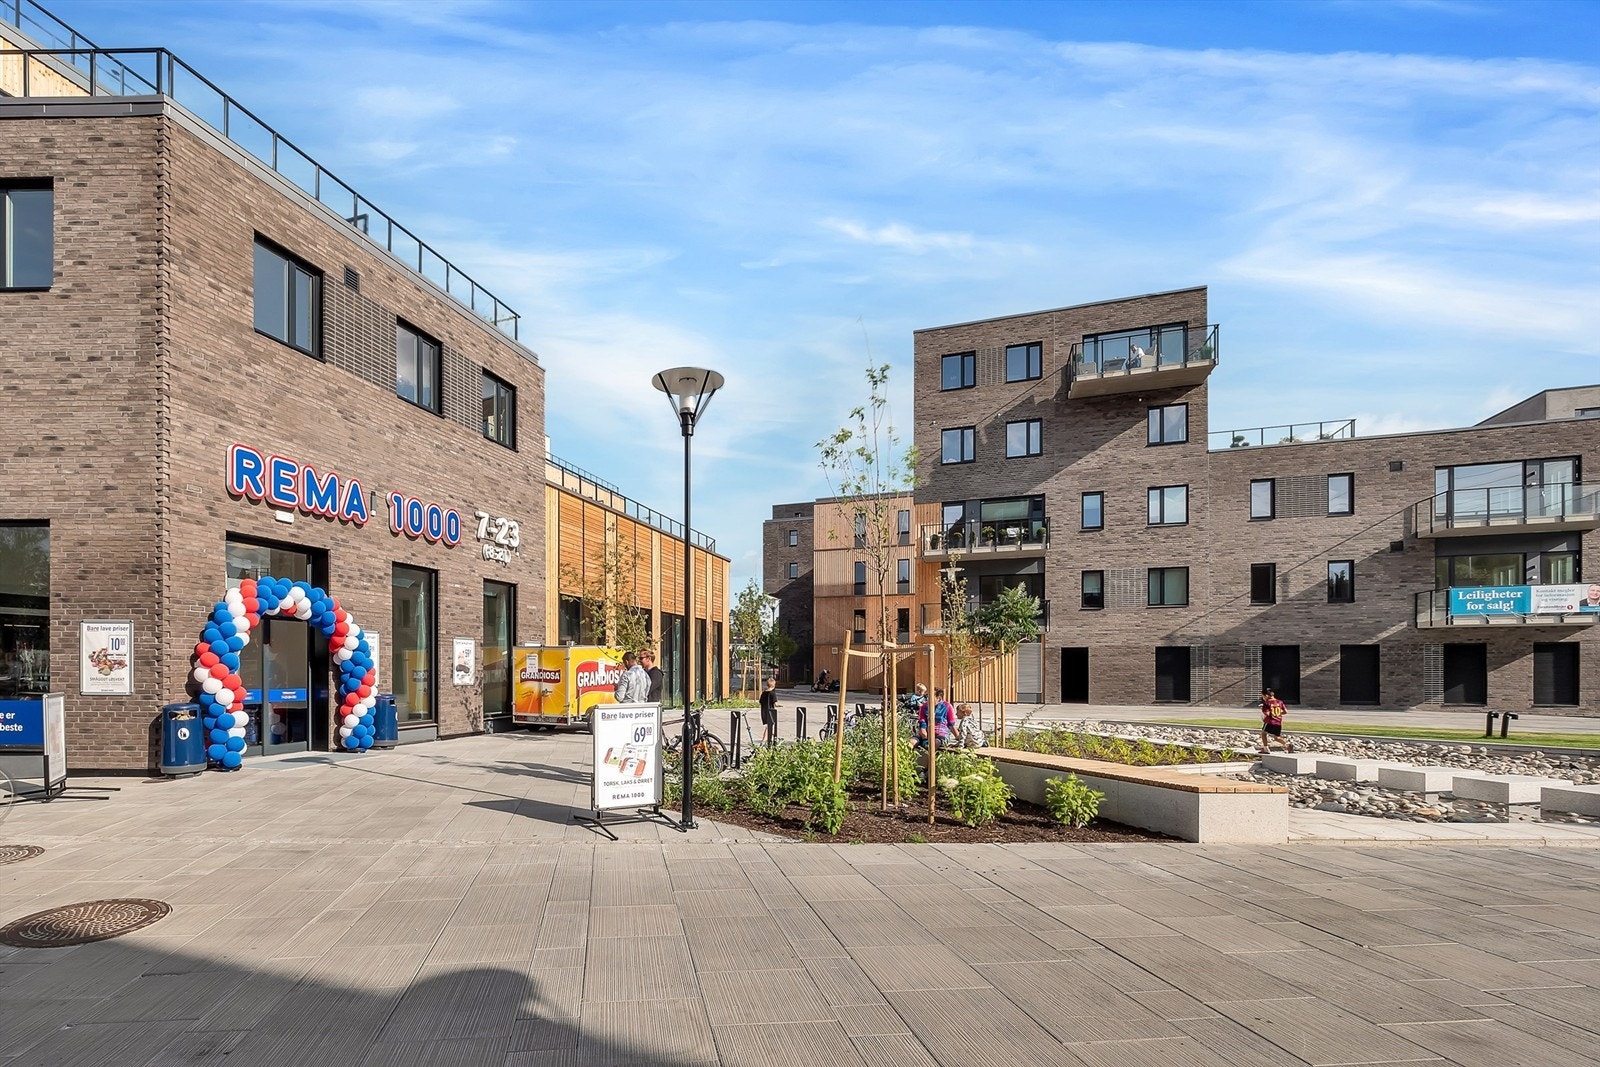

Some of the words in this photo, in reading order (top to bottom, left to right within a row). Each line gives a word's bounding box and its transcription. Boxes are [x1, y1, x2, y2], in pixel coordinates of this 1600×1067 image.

[227, 444, 368, 524] REMA
[387, 491, 462, 546] 1000
[474, 510, 520, 548] 7-23
[1458, 590, 1523, 600] Leiligheter
[1466, 602, 1484, 610] for
[1486, 600, 1514, 611] salg!
[521, 670, 560, 680] GRANDIOSA
[635, 711, 654, 719] priser
[634, 726, 646, 742] 69
